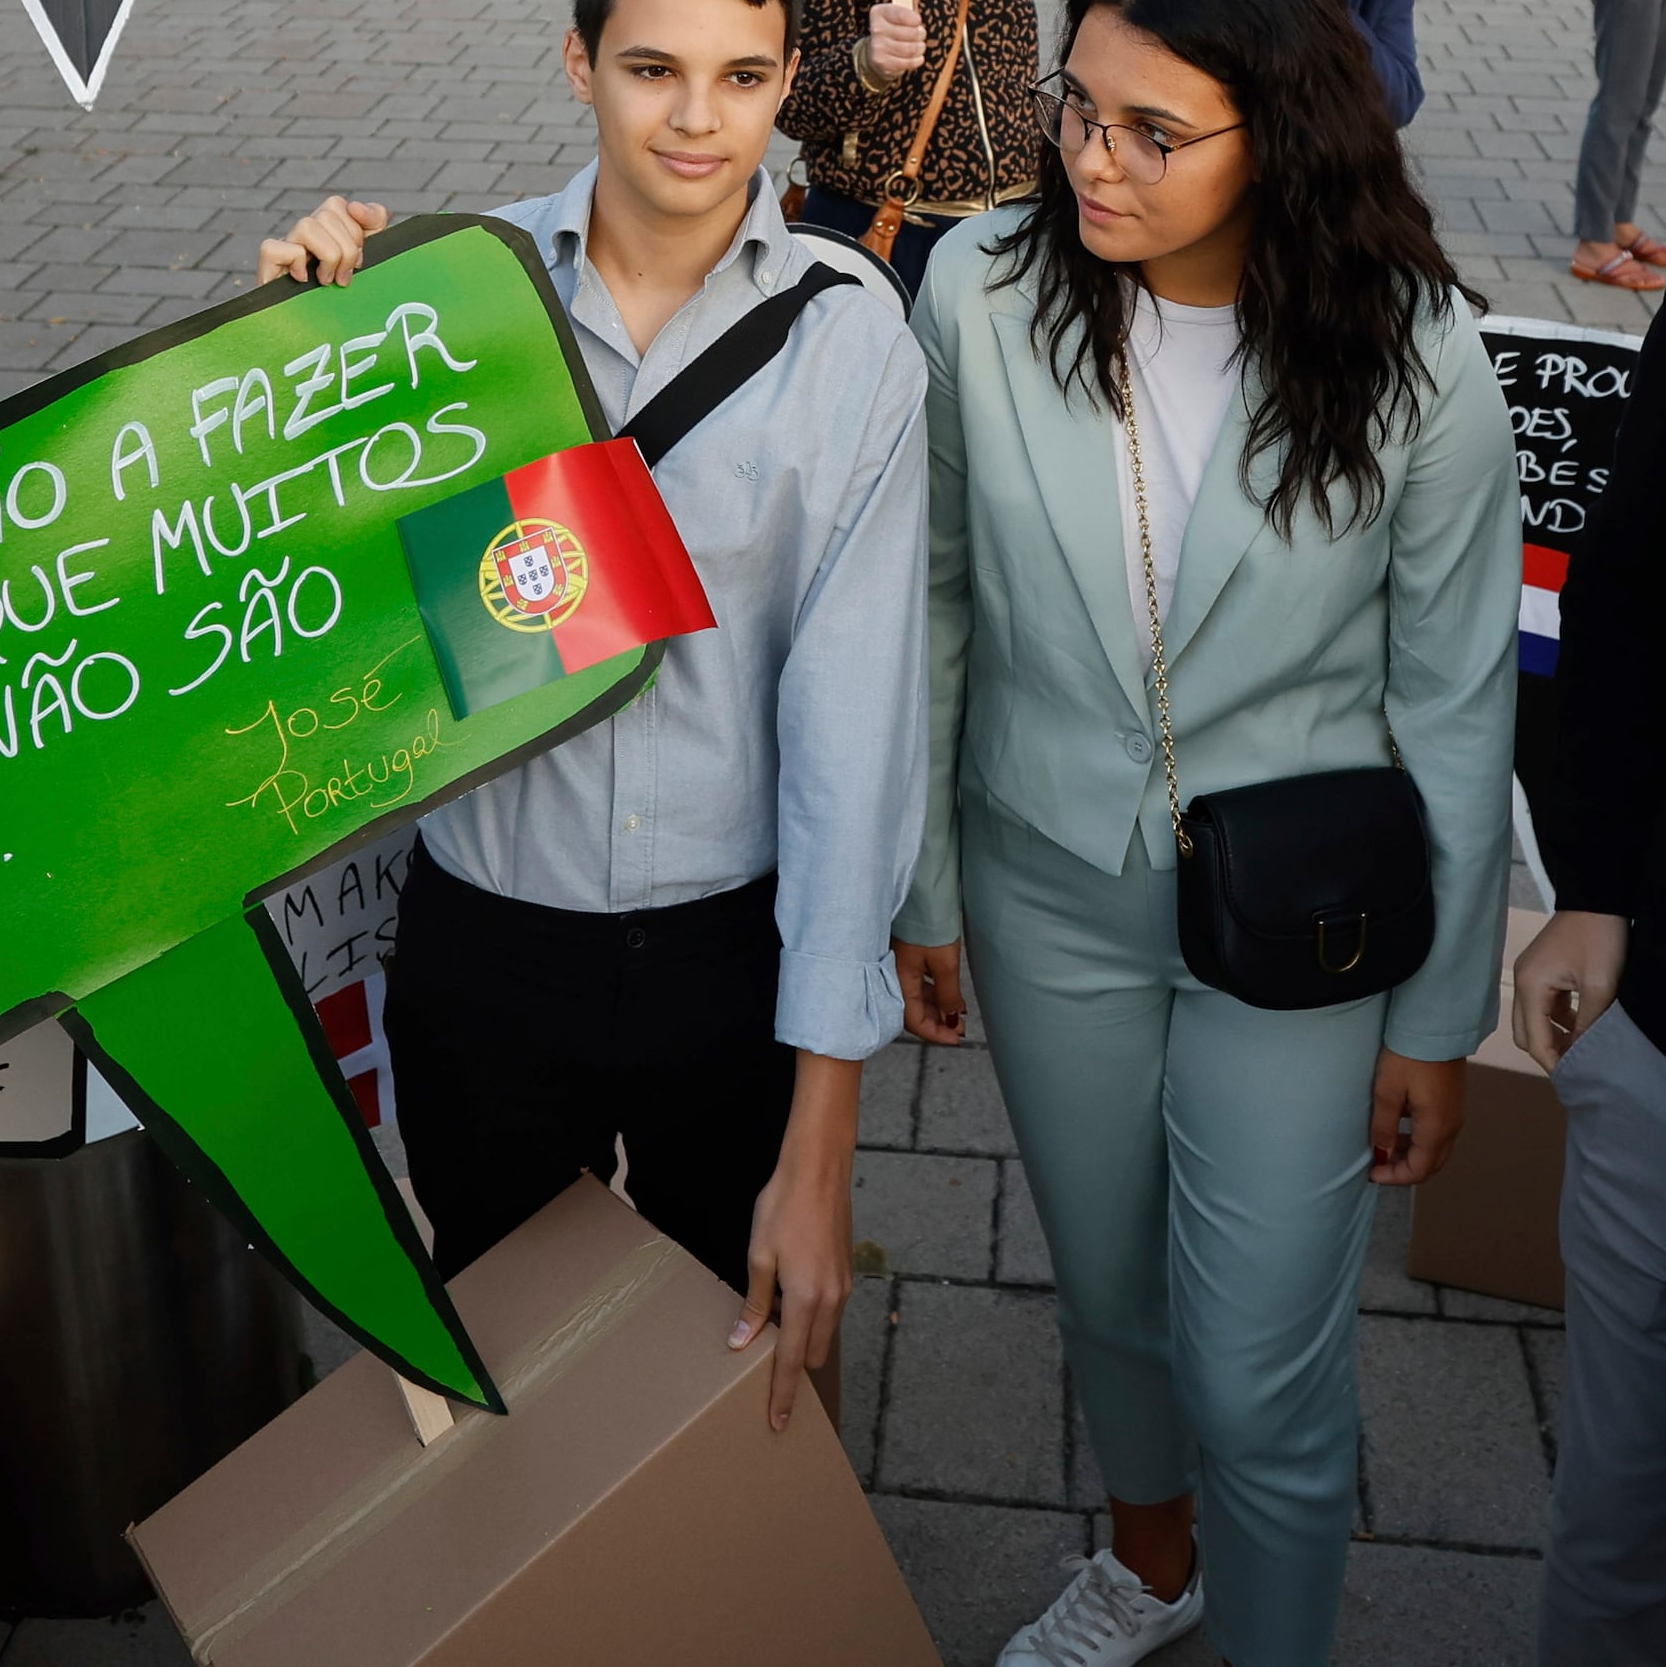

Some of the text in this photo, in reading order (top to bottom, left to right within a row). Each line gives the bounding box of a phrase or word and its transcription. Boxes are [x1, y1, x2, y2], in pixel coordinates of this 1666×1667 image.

[111, 421, 161, 502] A
[189, 301, 478, 467] FAZER
[151, 402, 487, 596] MUITOS
[168, 555, 343, 696] SÃO
